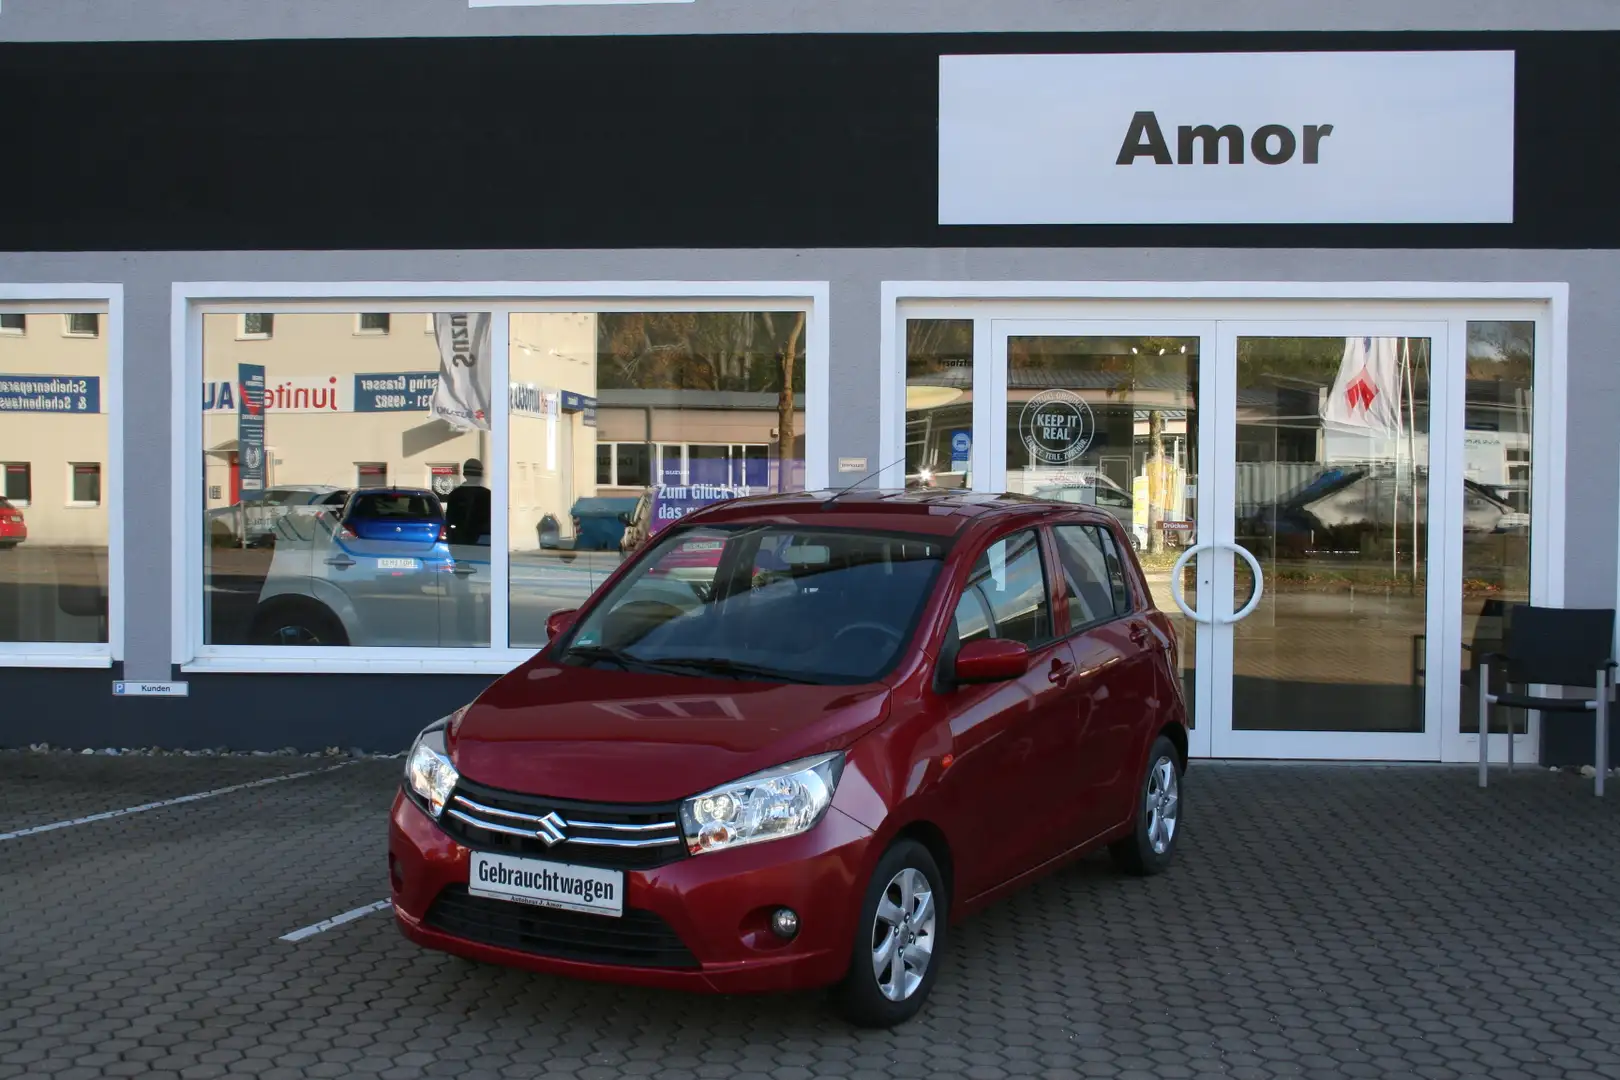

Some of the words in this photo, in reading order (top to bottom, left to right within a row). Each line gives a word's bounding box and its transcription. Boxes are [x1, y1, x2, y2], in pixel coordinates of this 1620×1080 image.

[1116, 110, 1334, 166] Amor
[1037, 414, 1064, 427] KEEP
[1067, 414, 1078, 428] IT
[1043, 427, 1070, 440] REAL
[658, 484, 686, 499] Zum
[691, 483, 730, 499] Glück
[658, 503, 682, 519] das
[478, 860, 614, 902] Gebrauchtwagen
